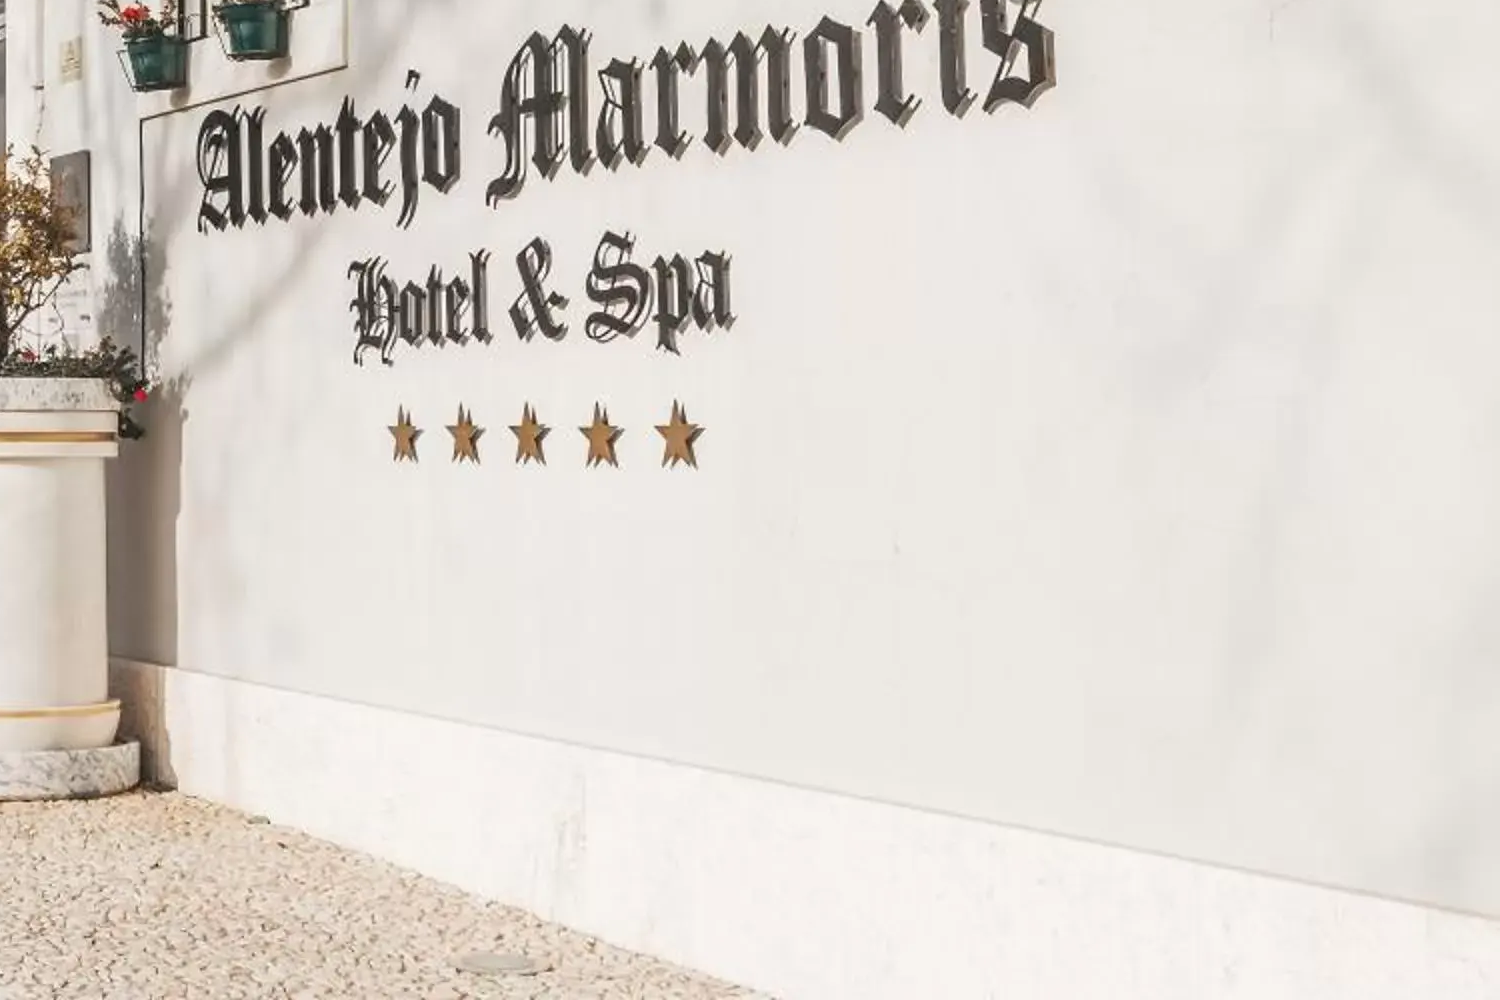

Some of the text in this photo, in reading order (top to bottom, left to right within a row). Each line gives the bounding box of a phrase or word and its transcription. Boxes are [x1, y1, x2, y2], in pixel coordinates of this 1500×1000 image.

[197, 69, 460, 232] Alentejo
[347, 230, 736, 367] Hotel & Spa
